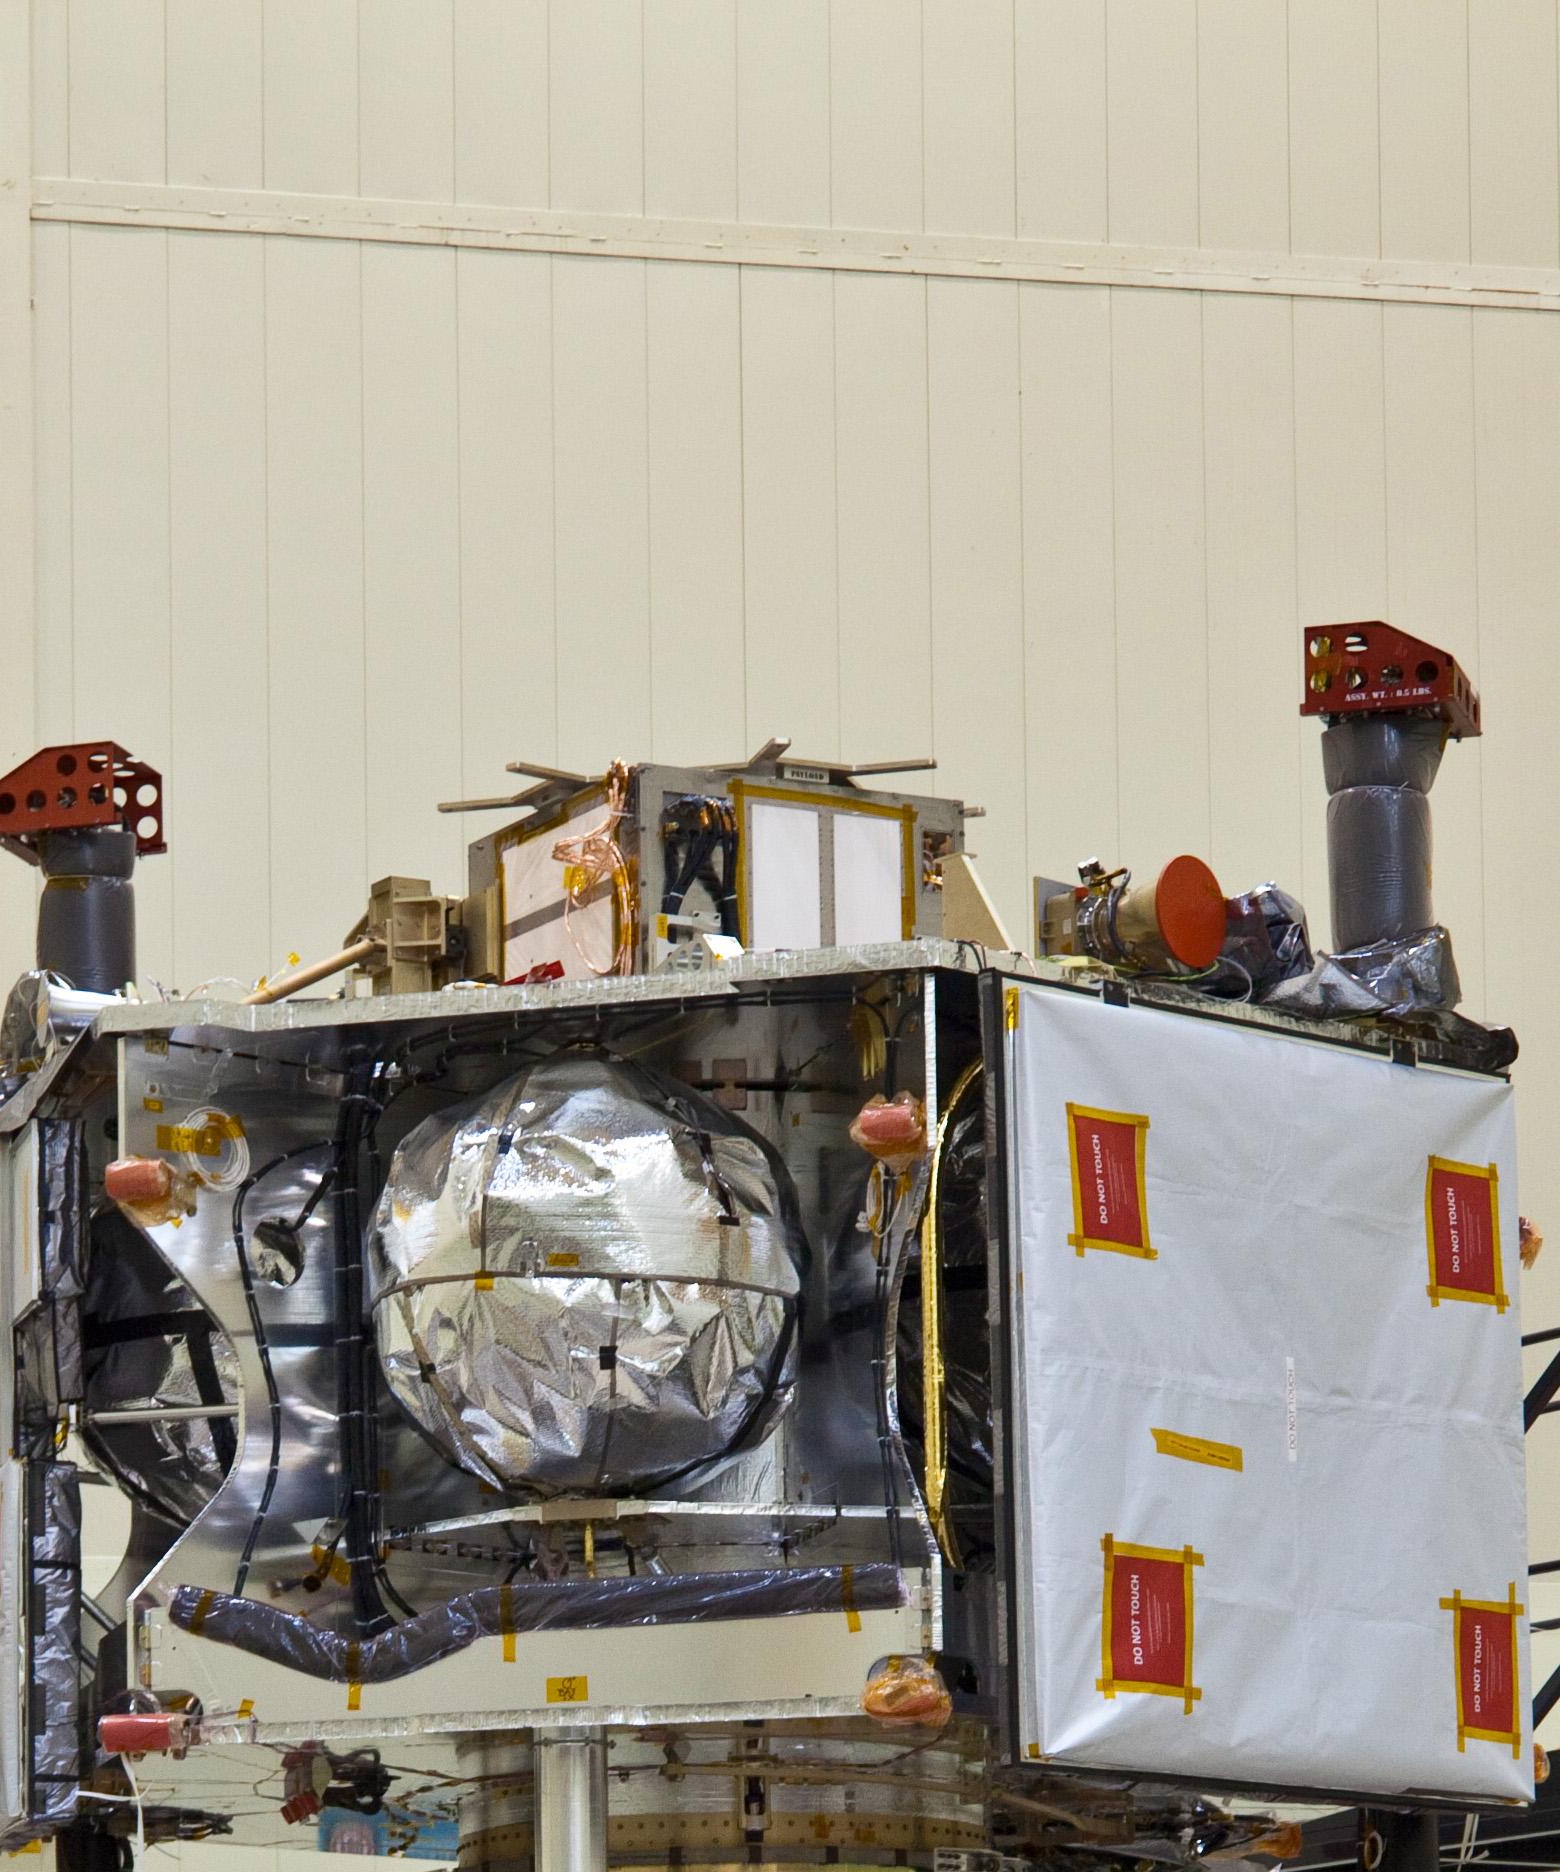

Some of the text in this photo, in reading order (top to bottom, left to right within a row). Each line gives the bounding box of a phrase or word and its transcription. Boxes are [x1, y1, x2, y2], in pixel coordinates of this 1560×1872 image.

[1091, 1134, 1108, 1224] DO NOT TOUCH
[1446, 1187, 1460, 1273] DO NOT TOUCH
[1130, 1574, 1143, 1665] DO NOT TOUCH
[1473, 1625, 1482, 1712] DO NOT TOUCH
